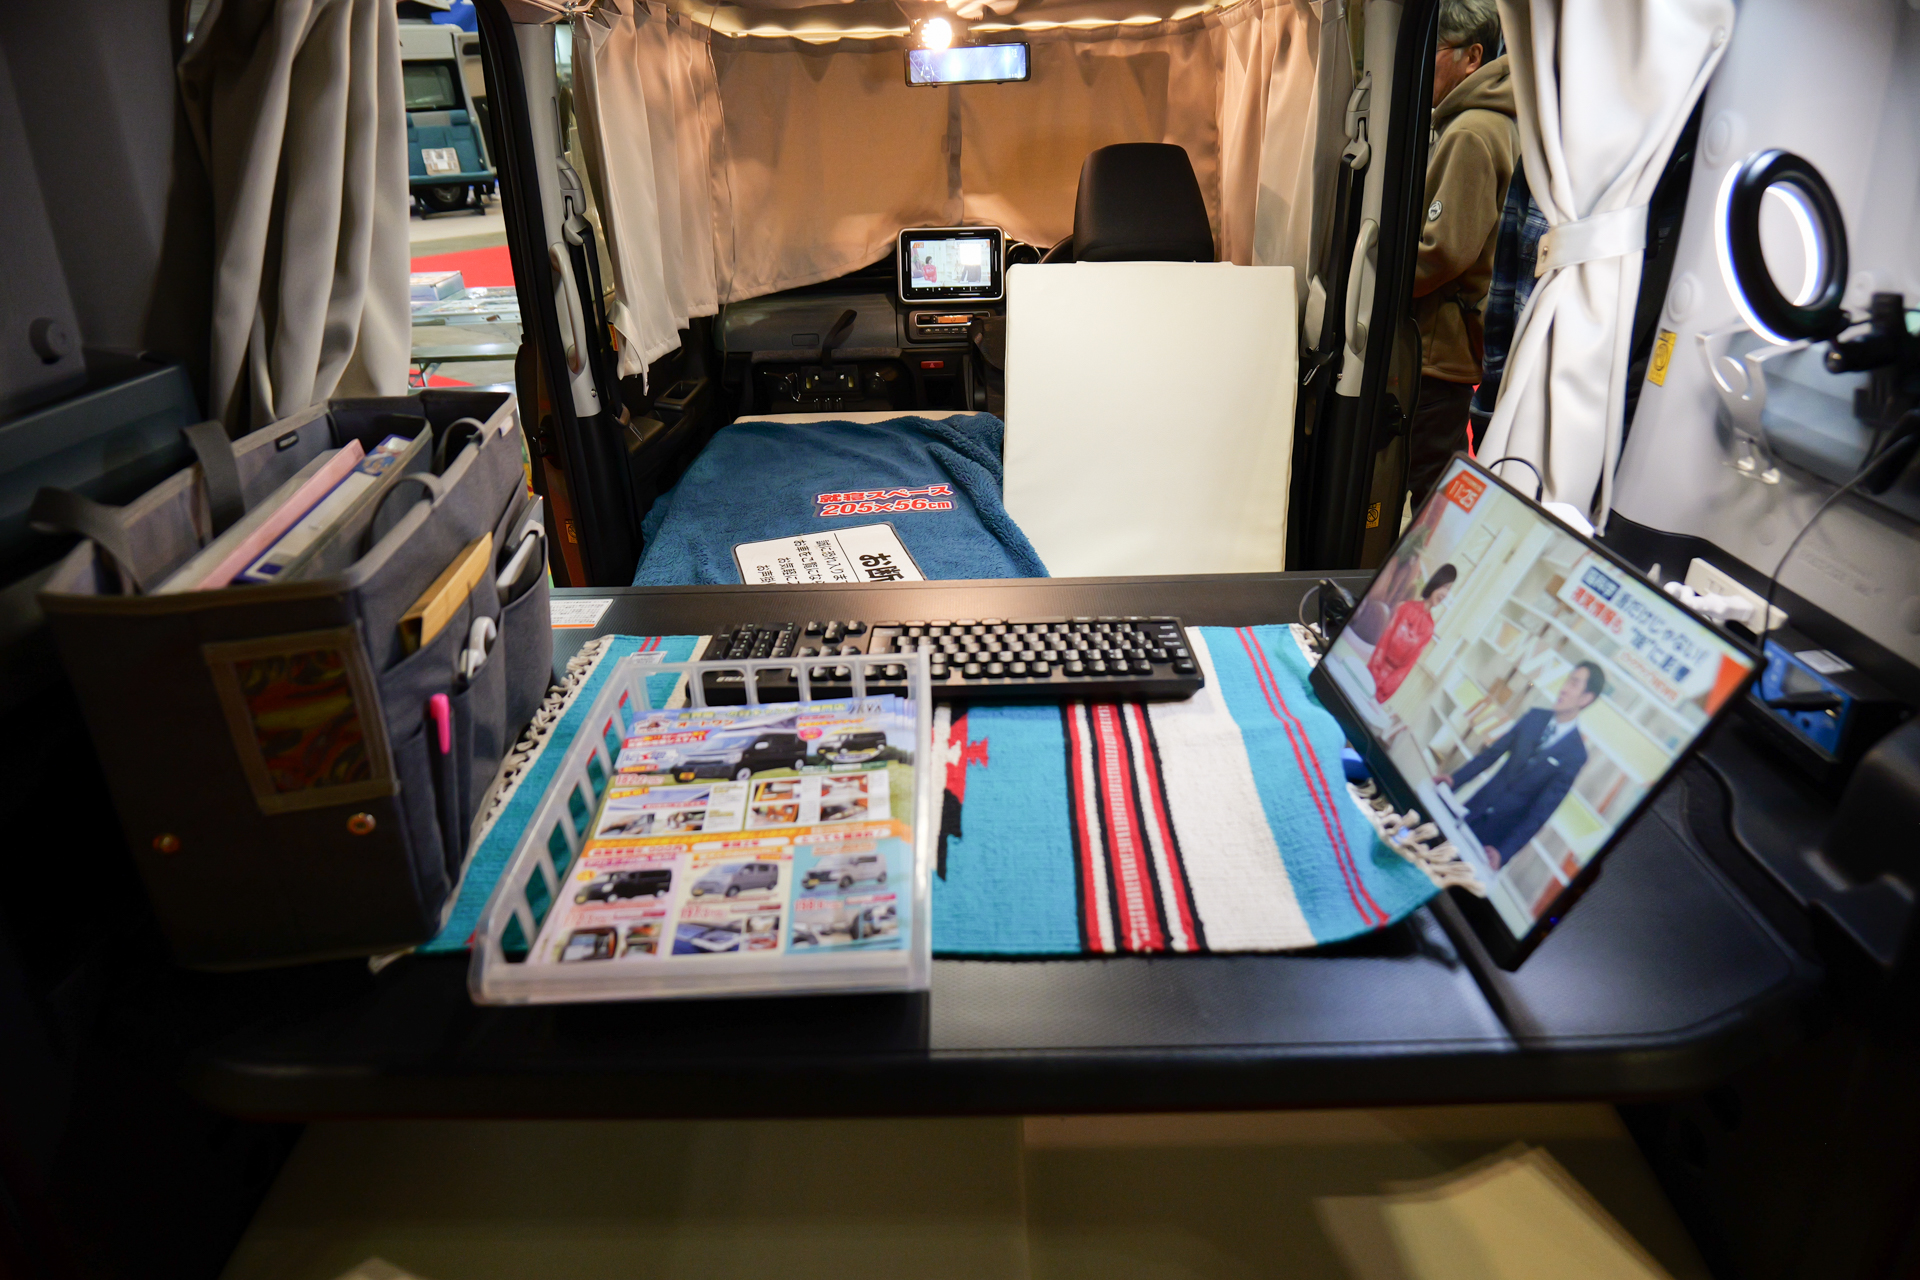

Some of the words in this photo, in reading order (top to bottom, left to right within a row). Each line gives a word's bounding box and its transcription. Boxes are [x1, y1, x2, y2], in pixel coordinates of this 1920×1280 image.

[818, 485, 953, 503] 就寝スペース
[815, 539, 849, 583] 誠に恐れ入りま
